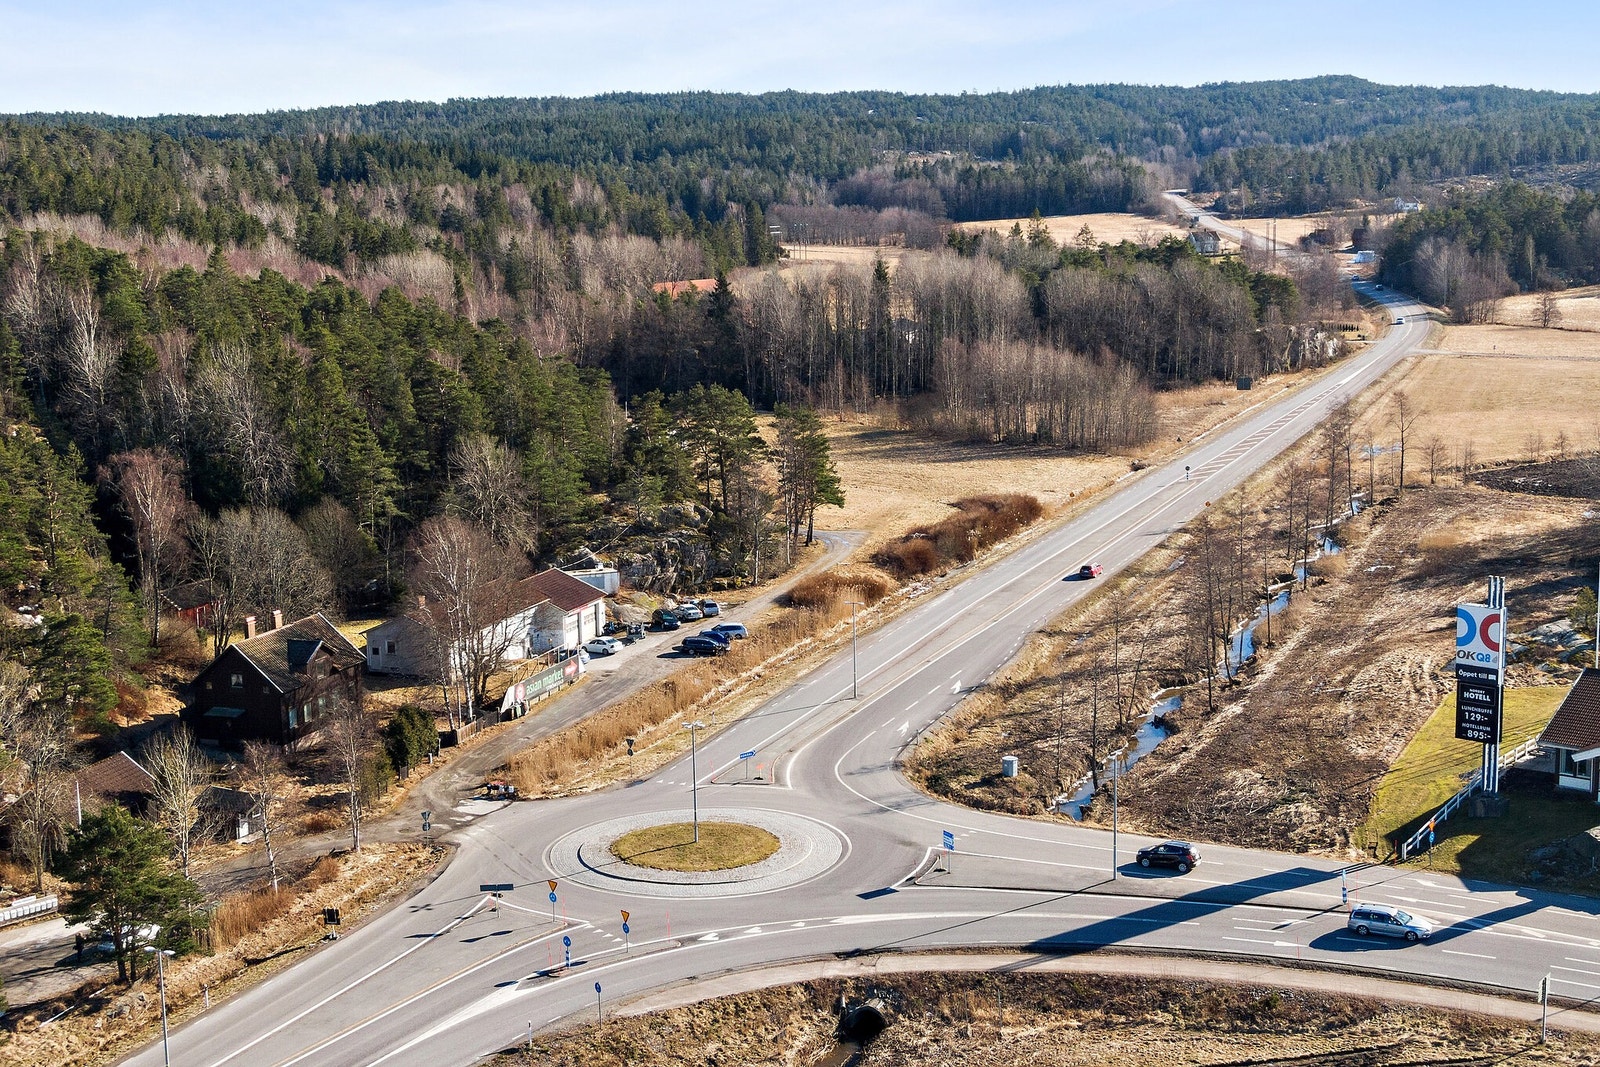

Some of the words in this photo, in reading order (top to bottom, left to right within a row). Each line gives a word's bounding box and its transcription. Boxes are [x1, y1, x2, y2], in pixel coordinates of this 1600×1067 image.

[1457, 650, 1491, 662] OKQ8
[1459, 669, 1477, 678] Öppet
[526, 680, 542, 695] asian
[543, 668, 564, 687] market
[1463, 691, 1491, 701] HOTELL
[1465, 712, 1488, 721] 129:-
[1461, 722, 1491, 731] HOTELLRUM
[1467, 729, 1491, 739] 895:-
